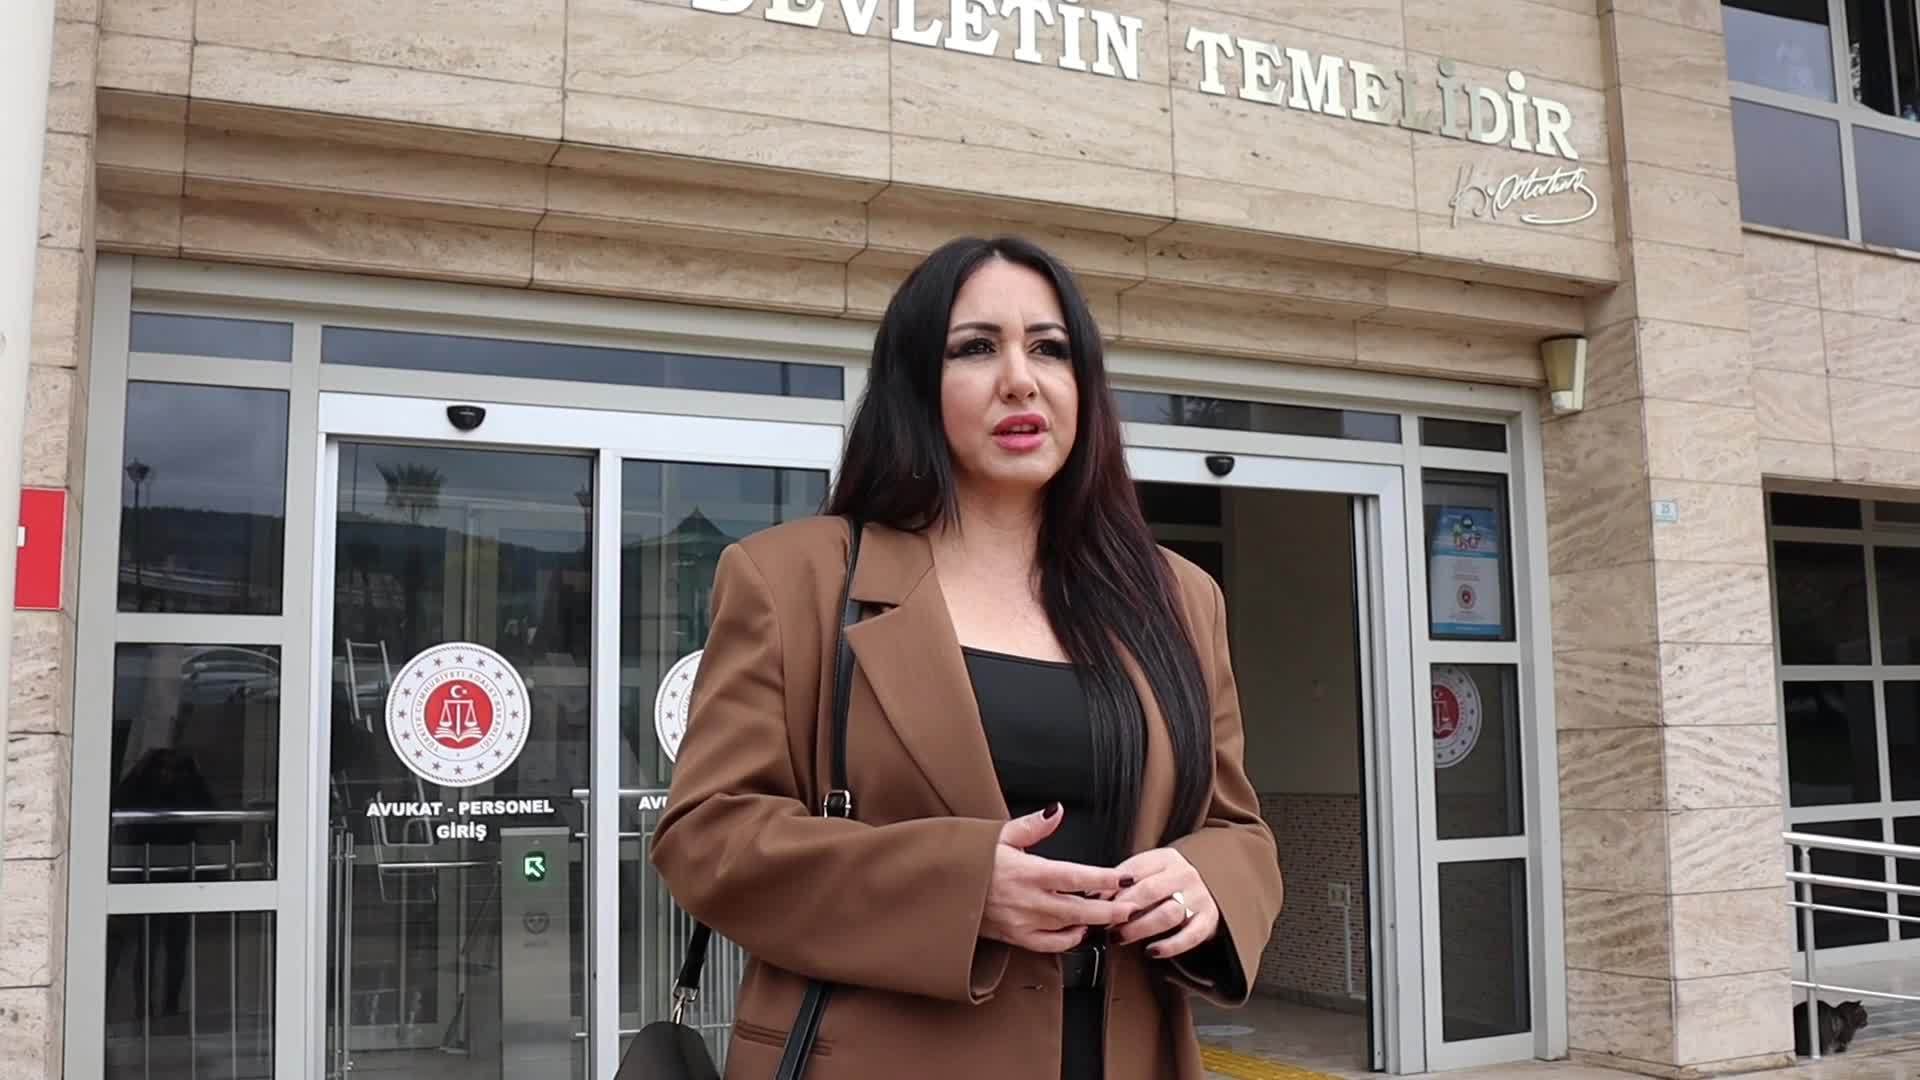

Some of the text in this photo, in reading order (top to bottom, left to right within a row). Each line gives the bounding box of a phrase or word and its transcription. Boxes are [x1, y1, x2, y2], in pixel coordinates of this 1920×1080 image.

[1185, 27, 1579, 160] TEMELİDİR
[367, 803, 443, 816] AVUKAT
[459, 800, 554, 816] PERSONEL
[436, 821, 487, 841] GİRİŞ
